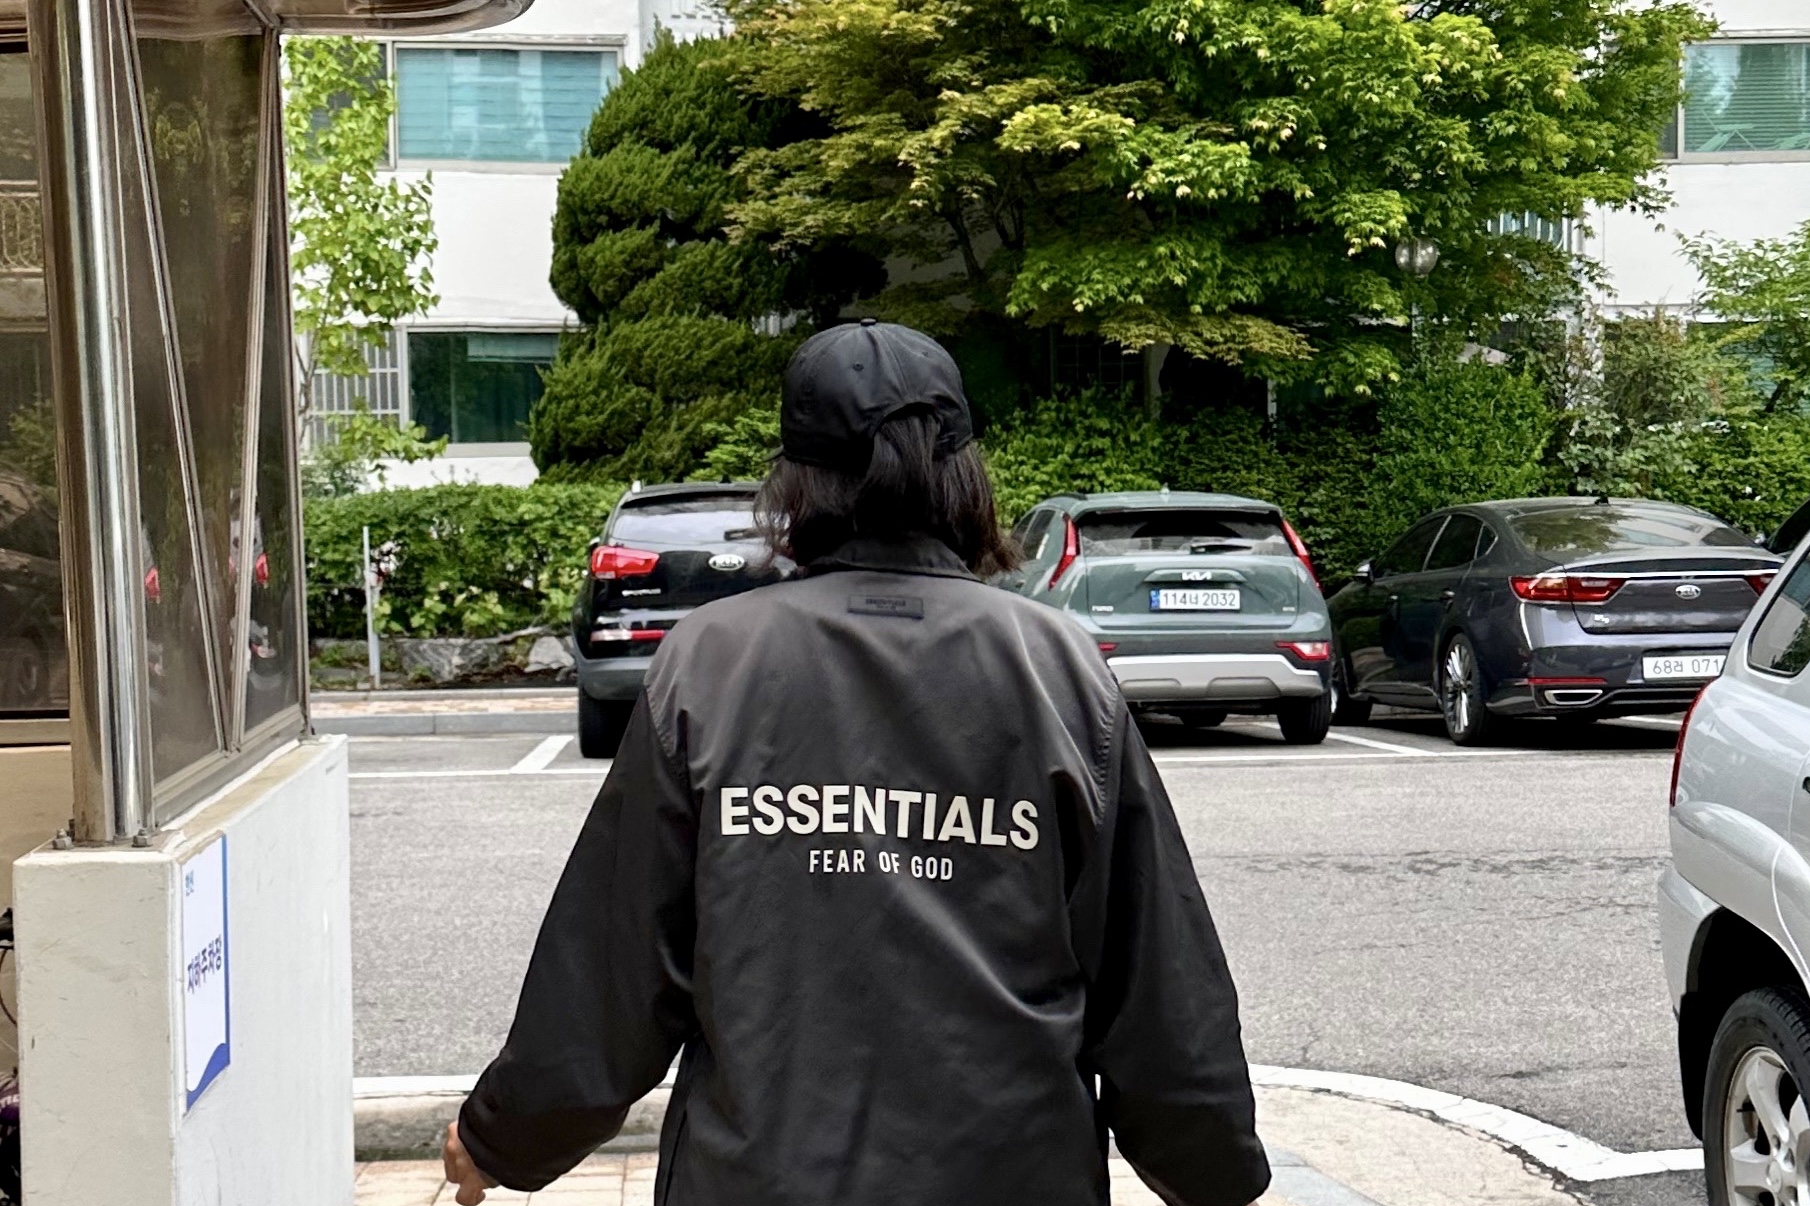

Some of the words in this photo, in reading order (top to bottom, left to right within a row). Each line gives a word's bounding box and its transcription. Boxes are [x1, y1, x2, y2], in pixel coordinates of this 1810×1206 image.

[1202, 592, 1236, 607] 2032
[1691, 658, 1720, 674] 071
[720, 784, 1040, 851] ESSENTIALS
[808, 849, 866, 874] FEAR
[878, 850, 900, 874] OF
[910, 855, 954, 881] GOD
[187, 933, 222, 995] 지하주차장
